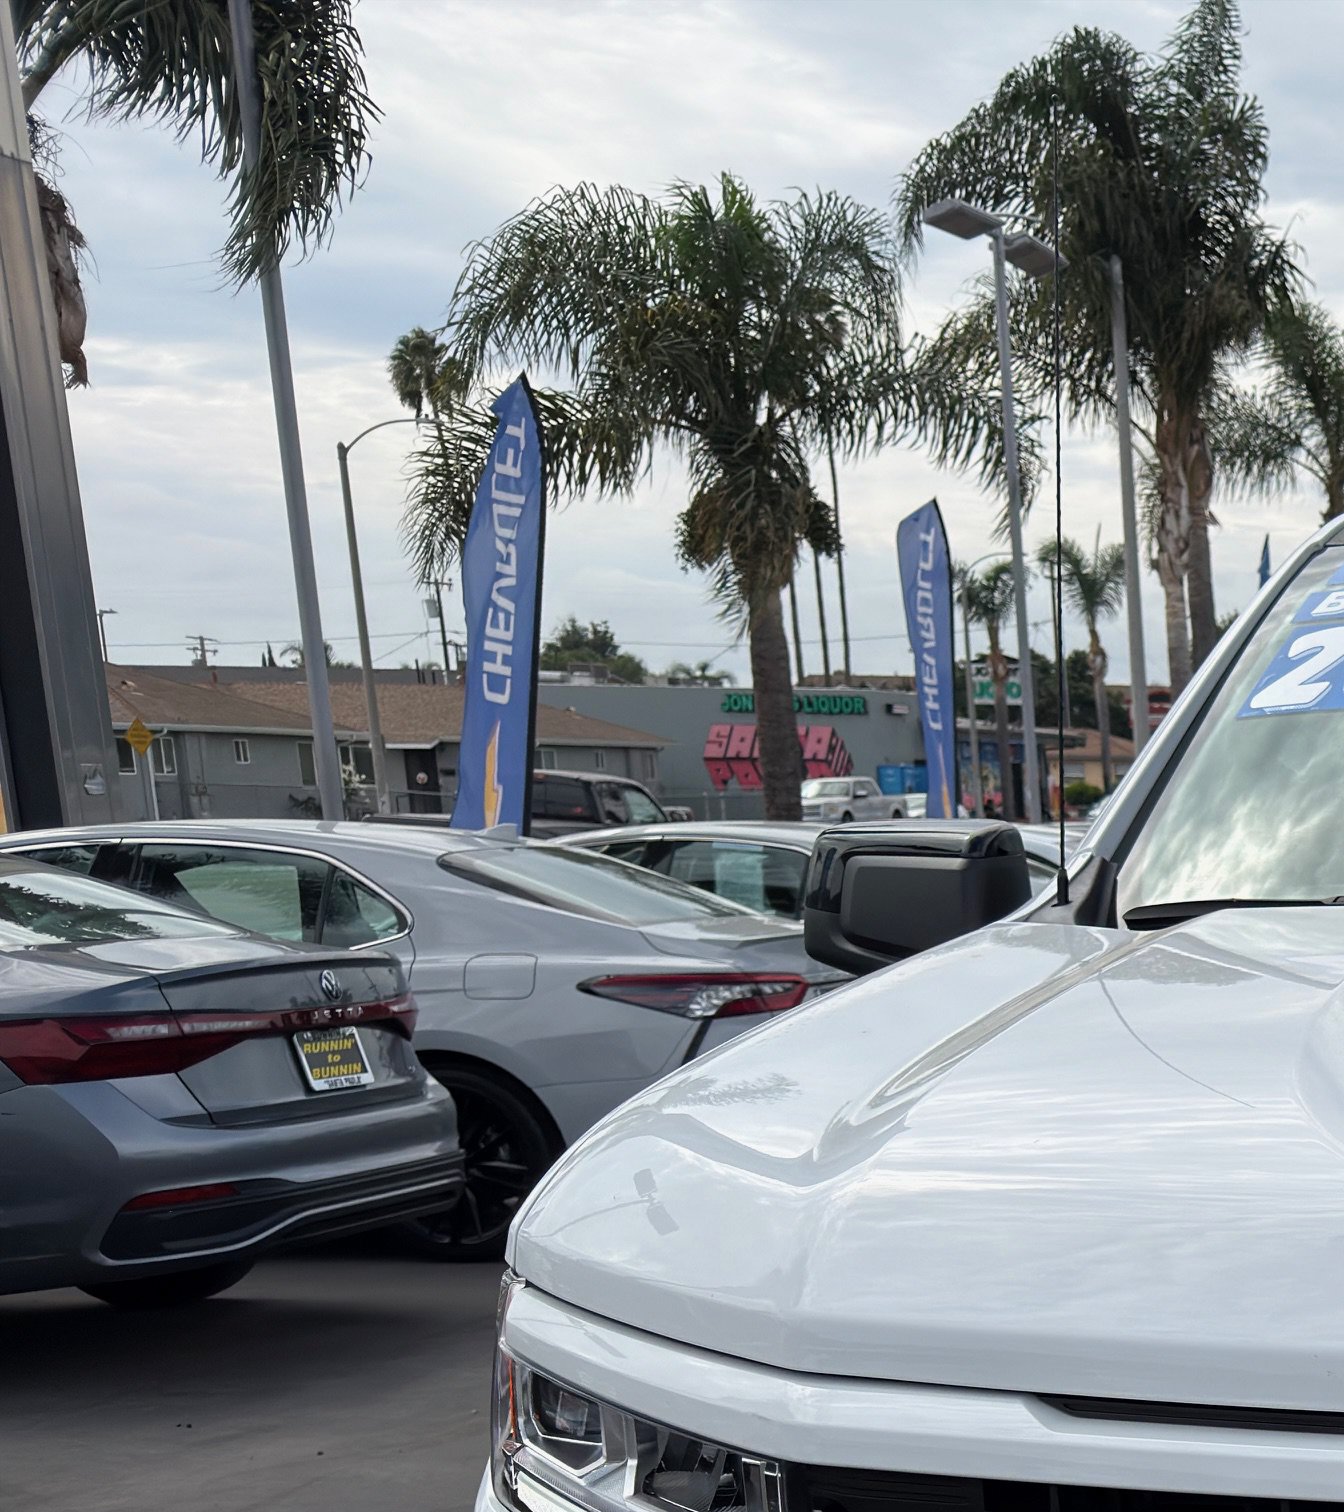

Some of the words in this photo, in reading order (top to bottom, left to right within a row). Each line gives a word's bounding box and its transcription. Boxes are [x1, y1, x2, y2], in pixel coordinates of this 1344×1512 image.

[802, 694, 867, 715] LIQUOR
[313, 1006, 363, 1019] JETTA
[303, 1038, 355, 1054] RUNNIN'
[327, 1054, 341, 1063] to
[312, 1062, 362, 1079] BUNNIN
